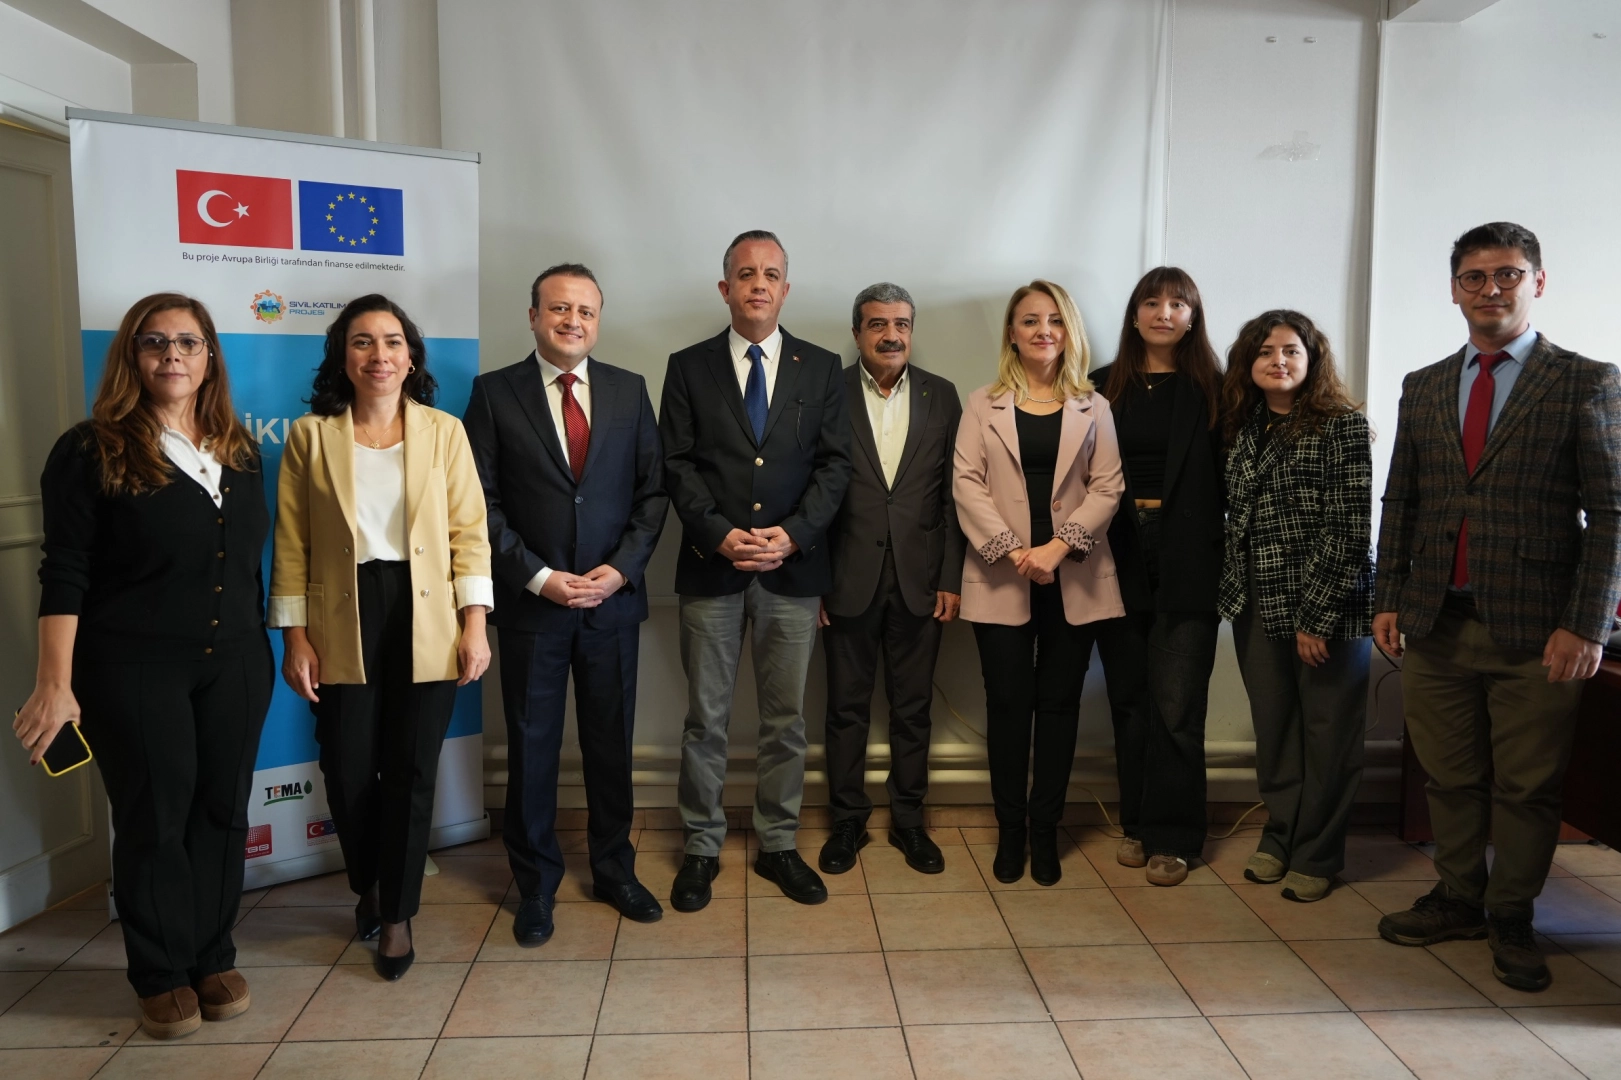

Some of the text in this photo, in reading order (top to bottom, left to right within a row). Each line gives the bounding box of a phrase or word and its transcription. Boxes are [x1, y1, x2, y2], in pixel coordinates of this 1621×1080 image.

[182, 252, 406, 272] Bu proje Avrupa Birliği tarafından finanse edilmektedir.
[264, 782, 303, 799] TEMA
